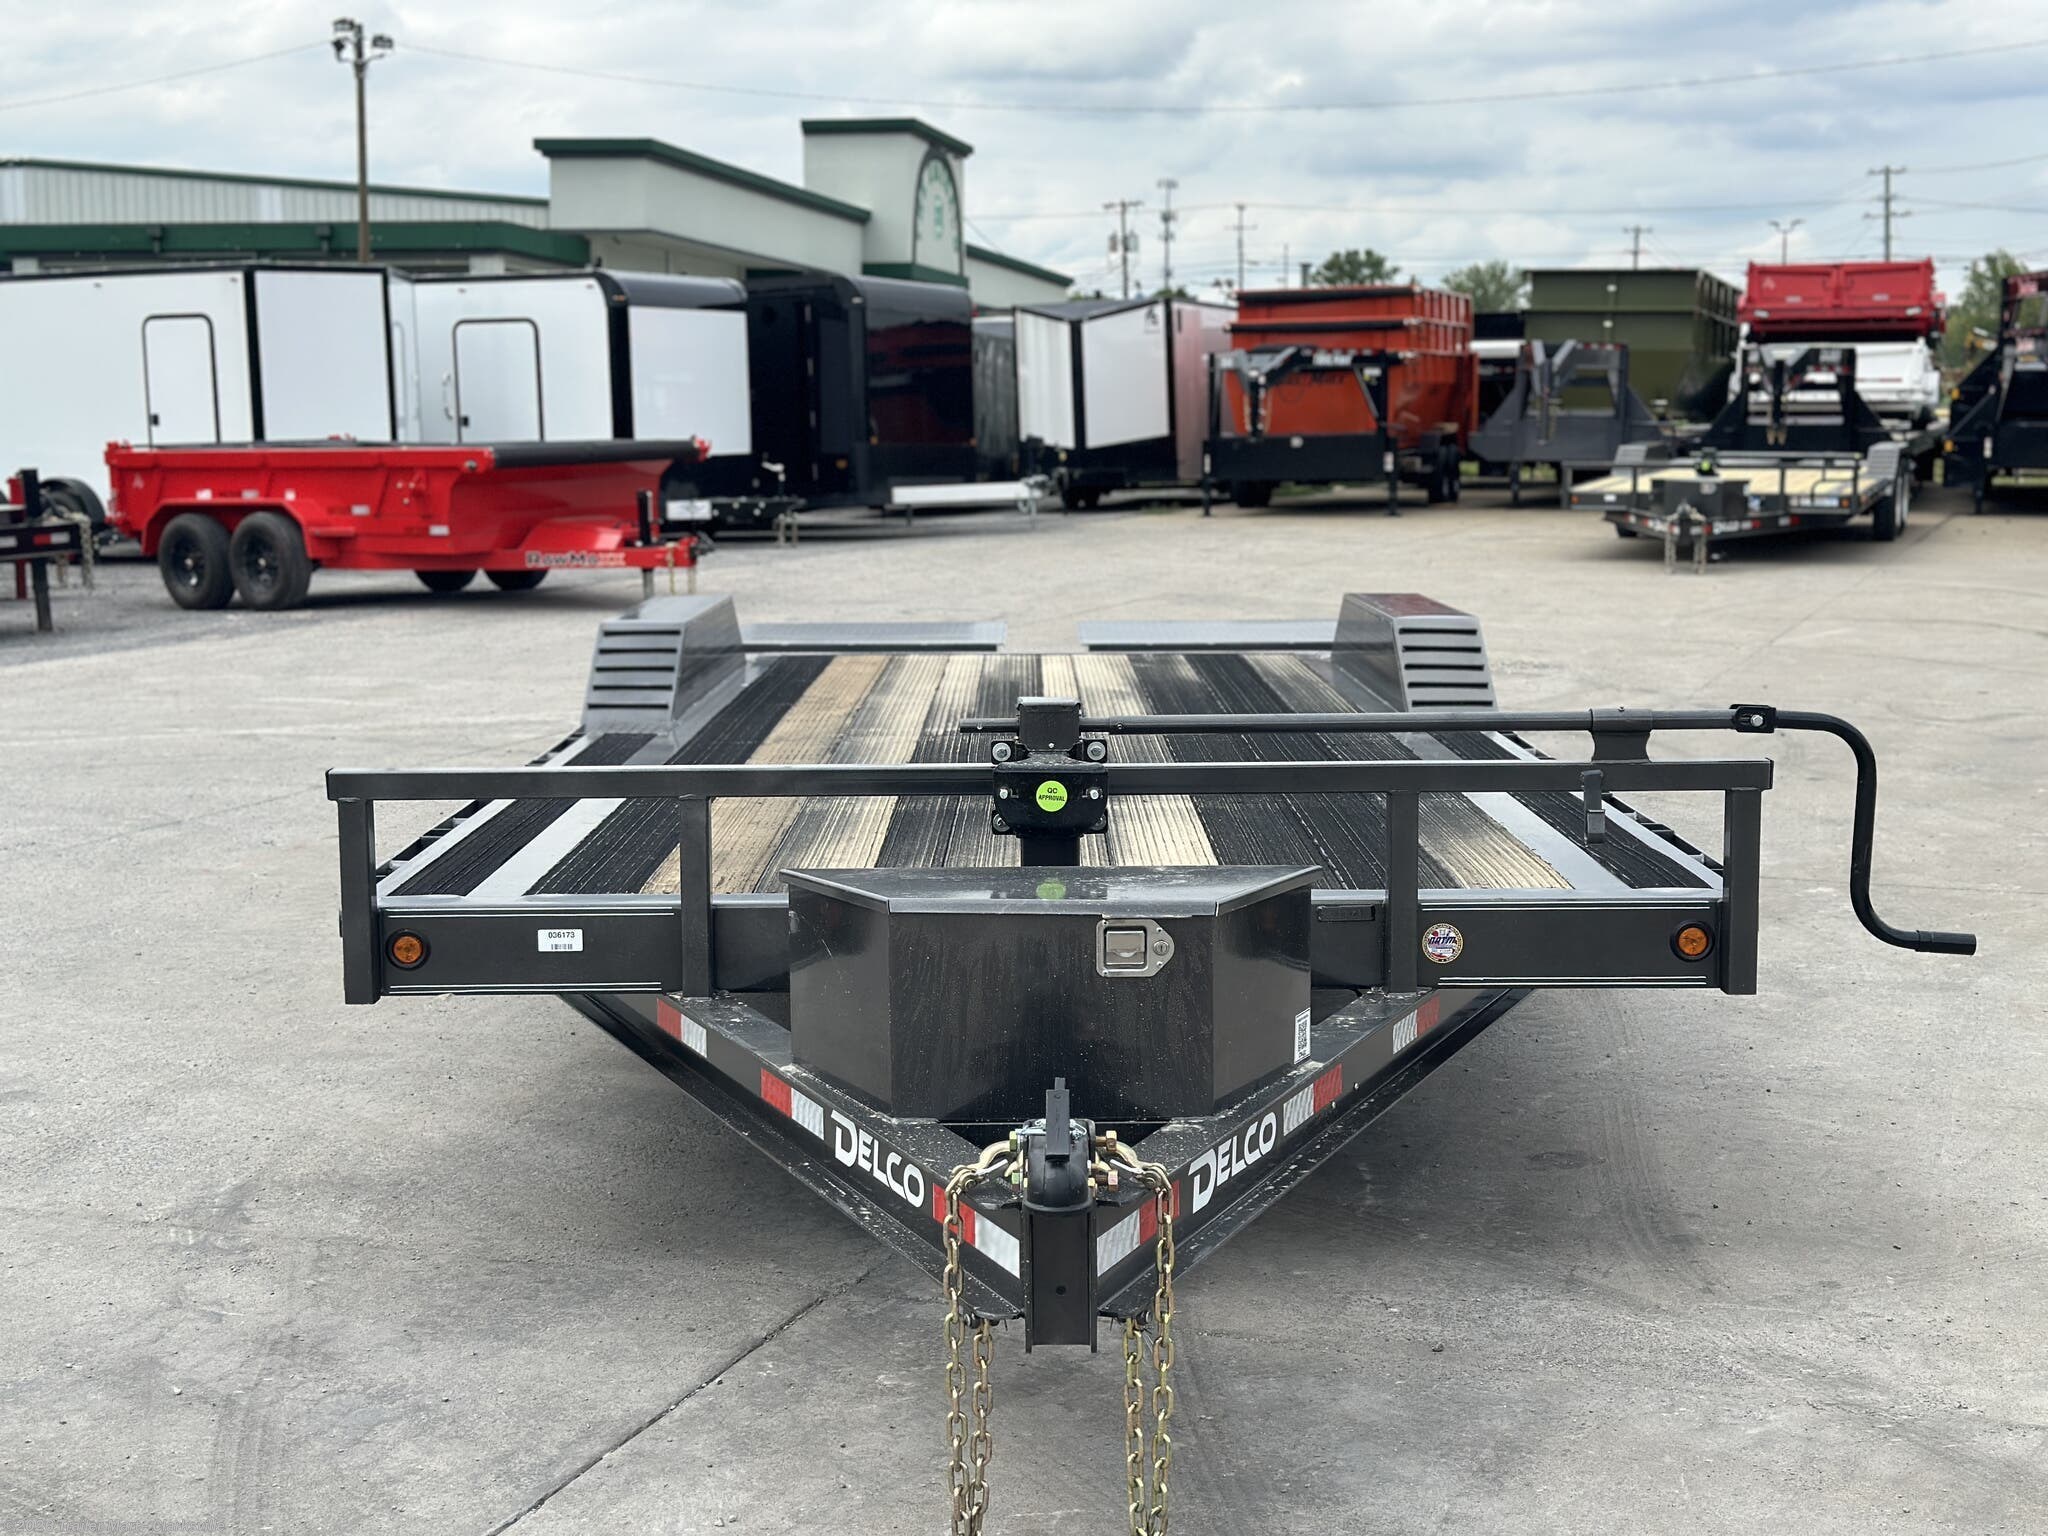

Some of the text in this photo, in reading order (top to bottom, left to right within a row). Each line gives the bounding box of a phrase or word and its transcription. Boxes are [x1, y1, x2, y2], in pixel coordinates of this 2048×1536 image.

[1038, 794, 1066, 802] APPROVAL
[548, 931, 576, 939] 036173
[831, 1109, 925, 1208] DELCO
[1188, 1111, 1277, 1214] DELCO
